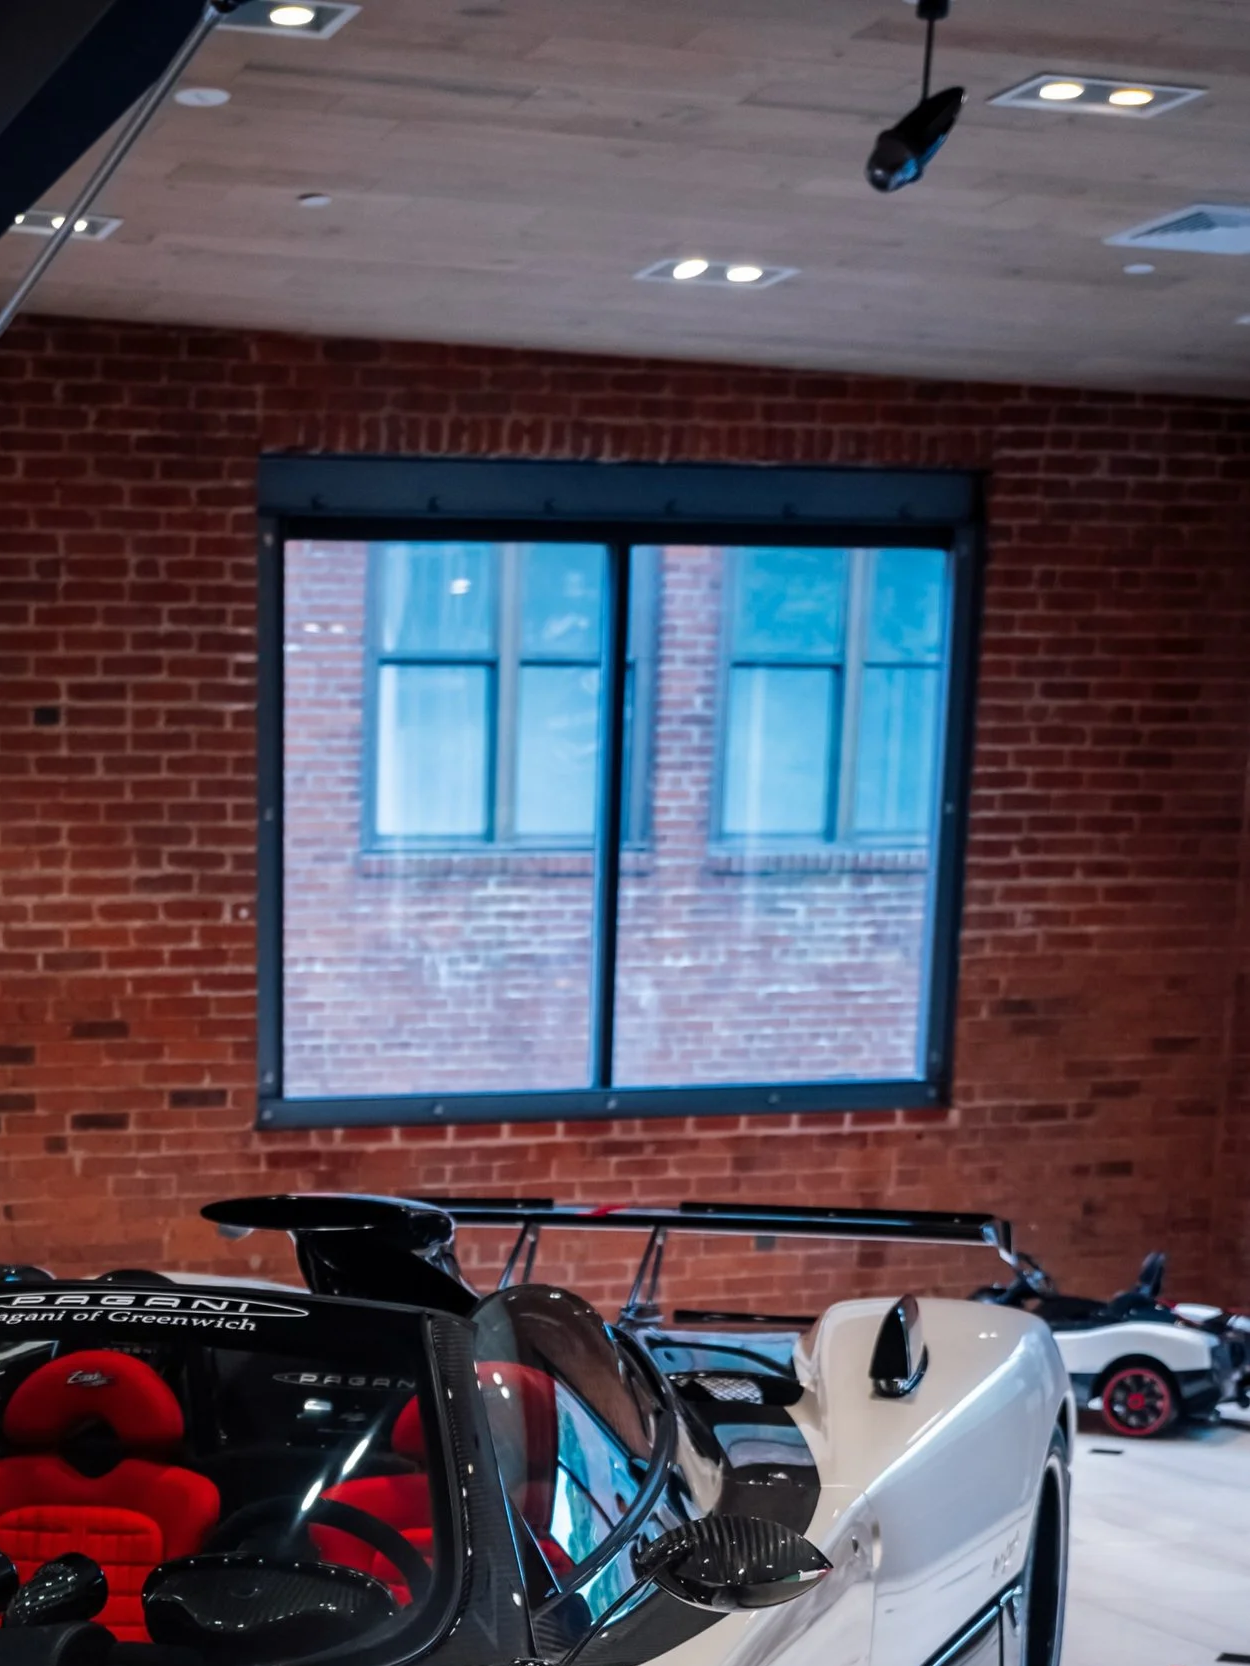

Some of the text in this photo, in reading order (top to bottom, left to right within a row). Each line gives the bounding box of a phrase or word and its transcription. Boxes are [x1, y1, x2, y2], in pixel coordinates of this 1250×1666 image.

[11, 1295, 249, 1313] PAGANI
[72, 1310, 104, 1322] of
[107, 1310, 257, 1332] Greenwich
[299, 1373, 416, 1389] PAGAN
